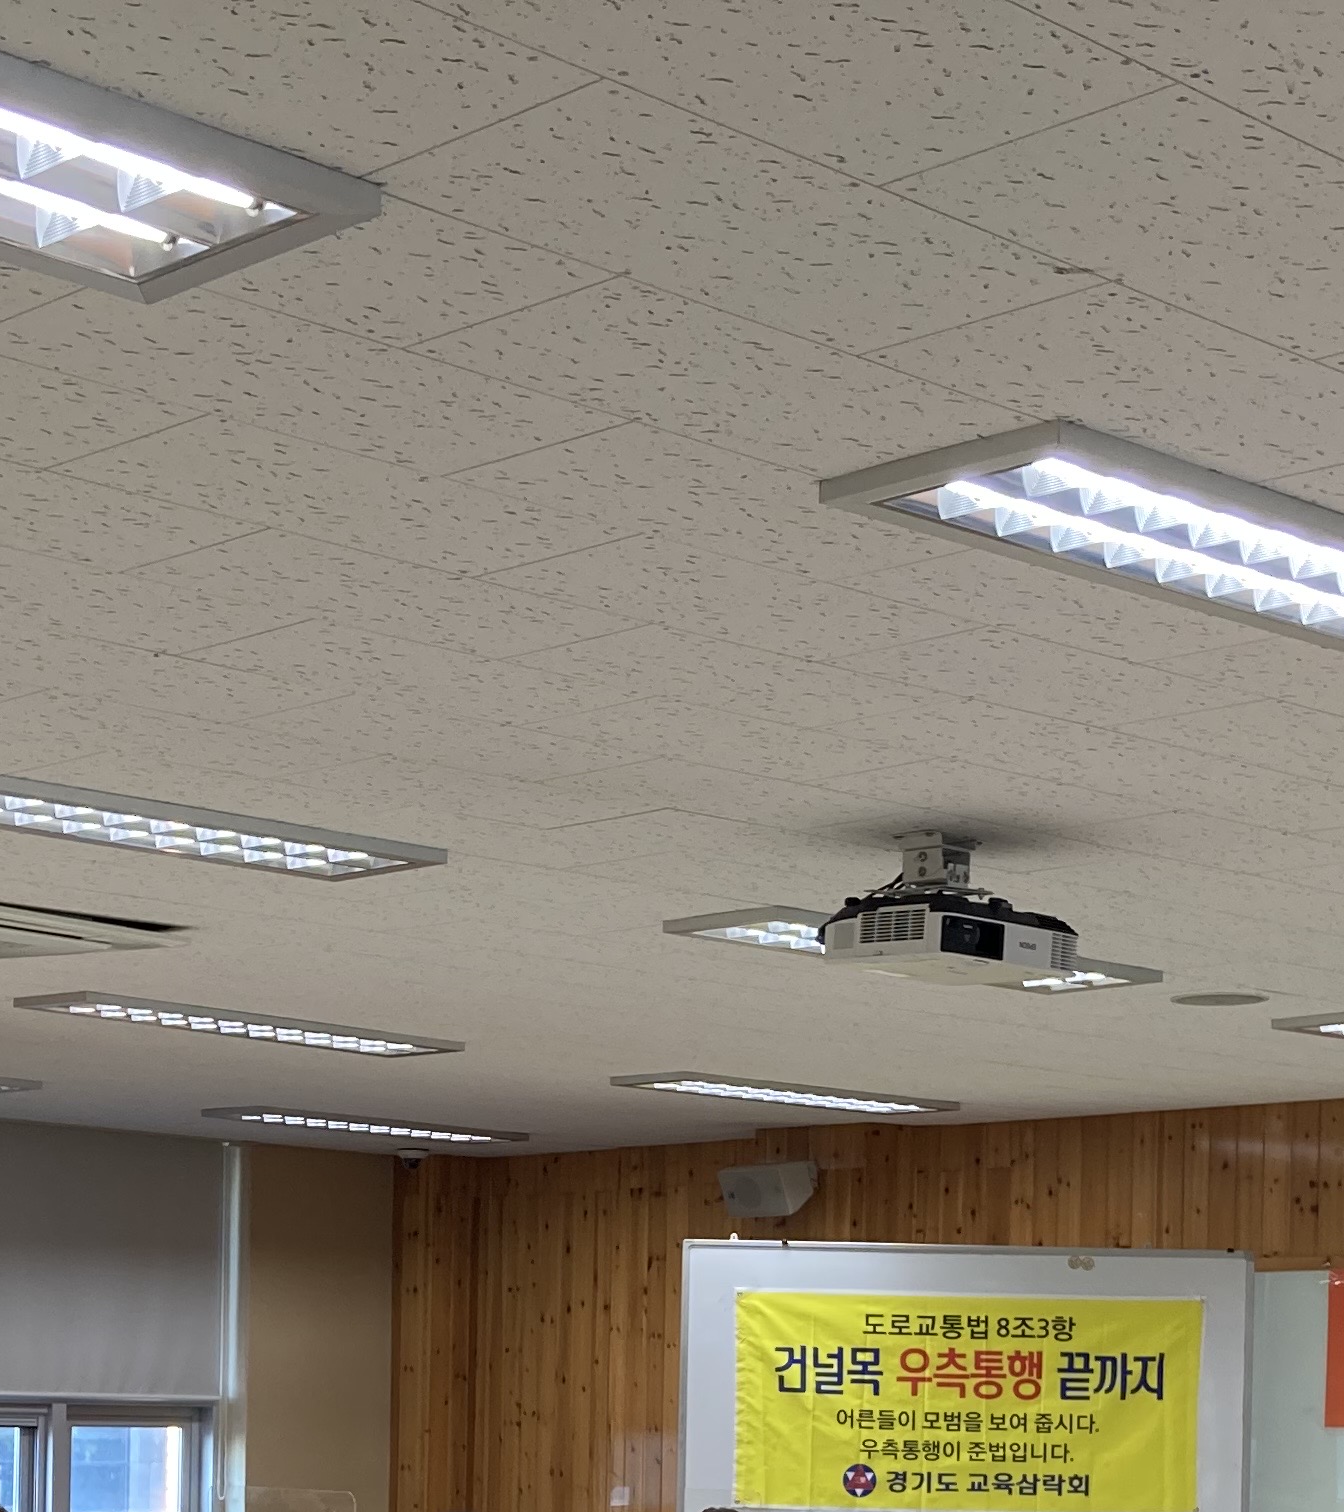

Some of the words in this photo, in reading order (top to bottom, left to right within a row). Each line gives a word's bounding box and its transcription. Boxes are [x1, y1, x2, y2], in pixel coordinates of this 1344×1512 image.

[862, 1313, 989, 1340] 도로교통법
[996, 1315, 1077, 1342] 8조3항
[774, 1345, 884, 1397] 건널목
[896, 1347, 1044, 1401] 우측통행
[1057, 1351, 1166, 1401] 끝까지
[836, 1408, 916, 1431] 어른들이
[921, 1410, 984, 1432] 모범을
[988, 1412, 1028, 1433] 보여
[1034, 1413, 1100, 1435] 줍시다.
[859, 1438, 961, 1462] 우측통행이
[967, 1441, 1075, 1464] 준법입니다.
[886, 1470, 959, 1494] 경기도
[966, 1472, 1091, 1497] 교육삼락회
